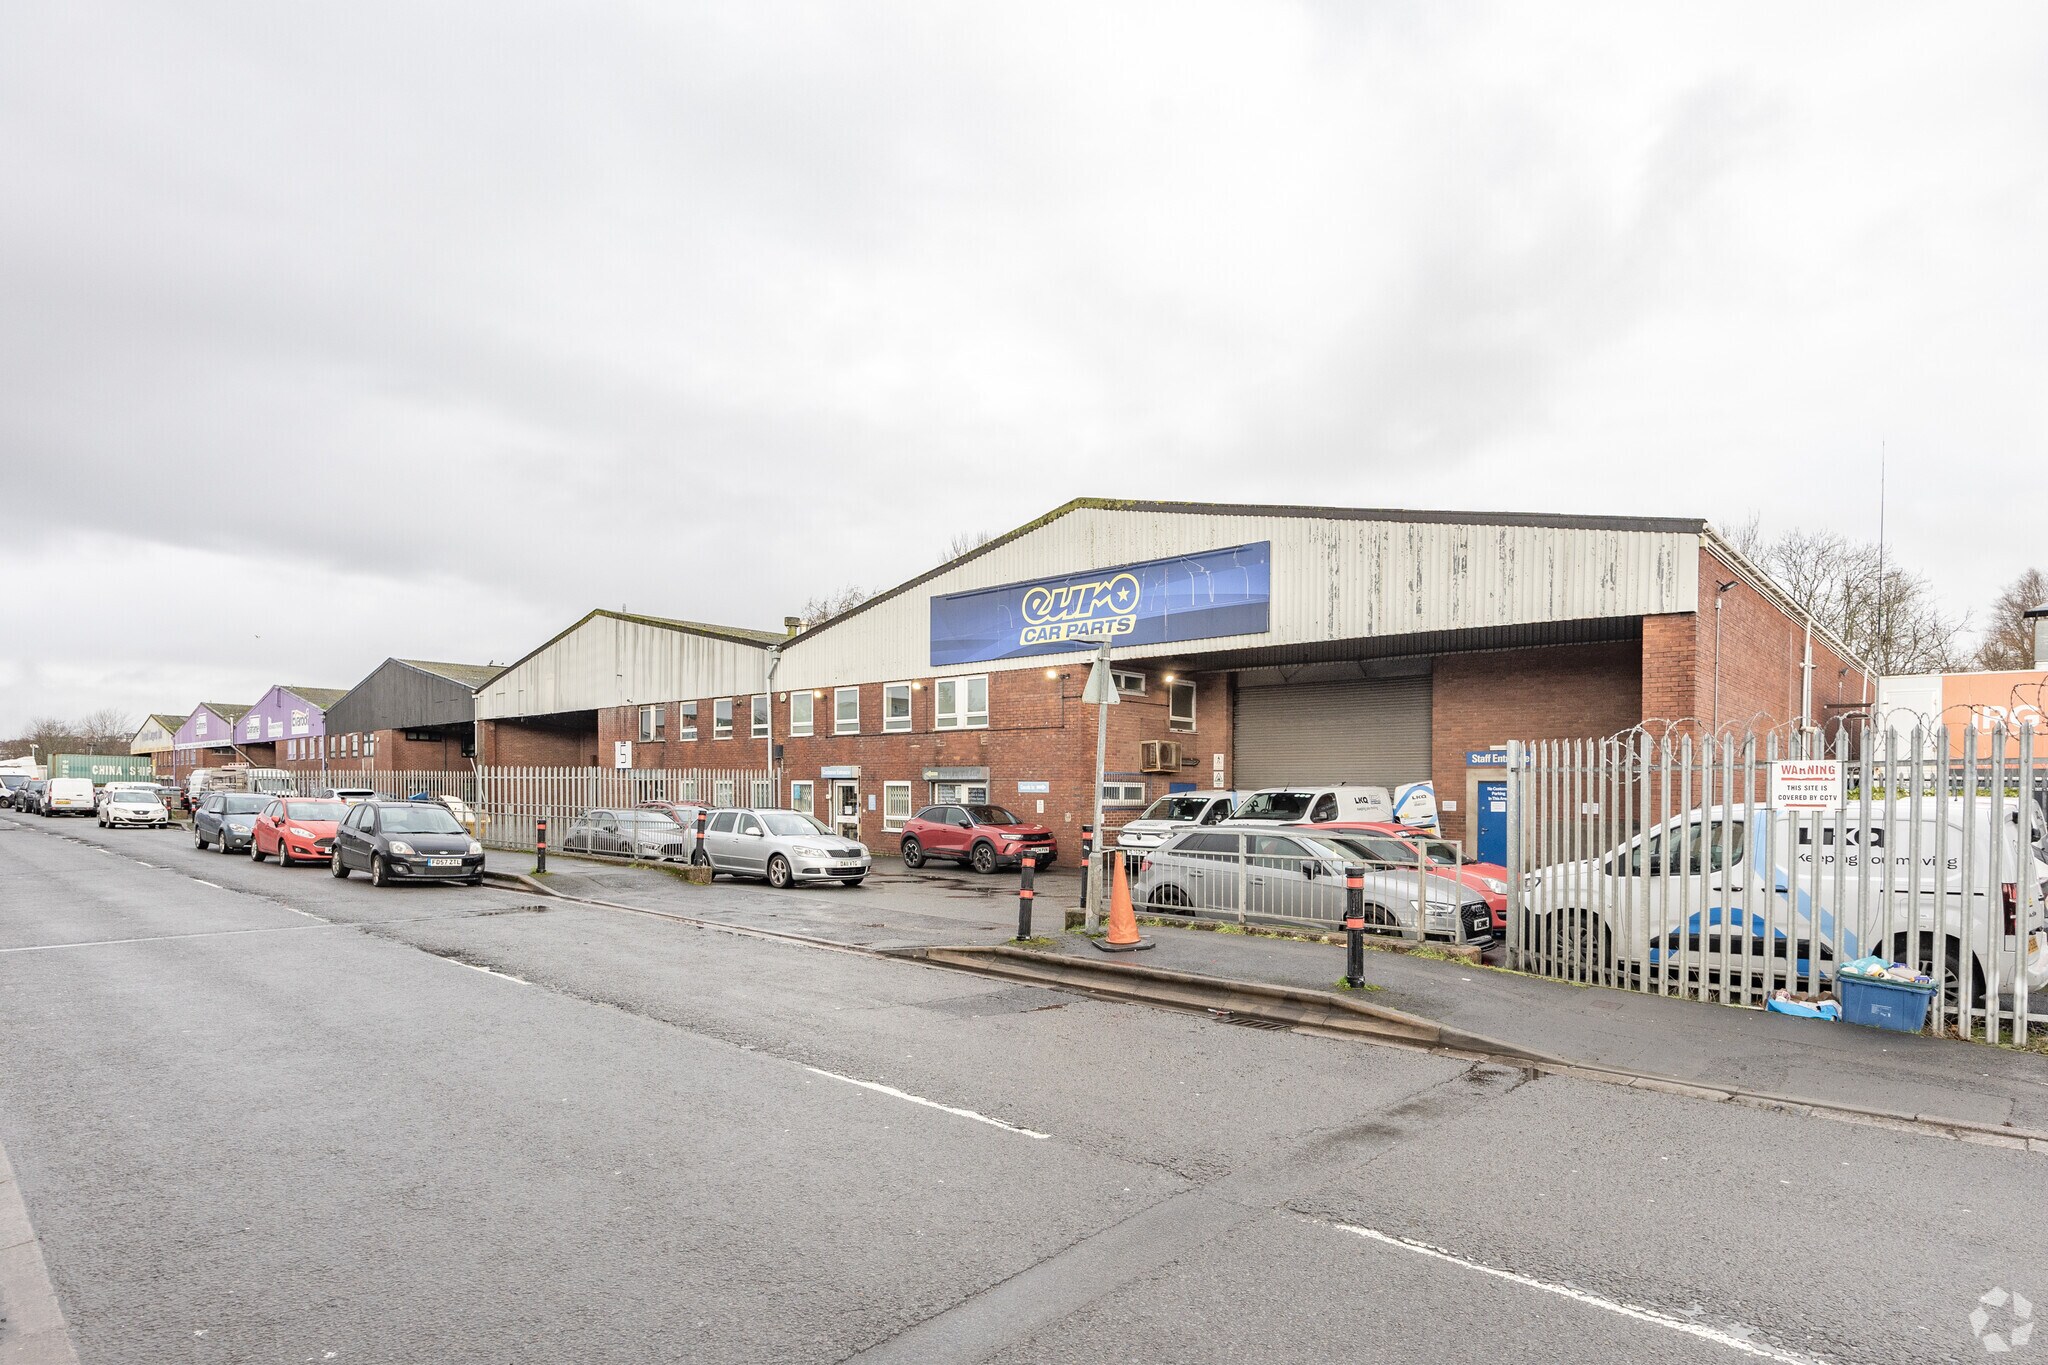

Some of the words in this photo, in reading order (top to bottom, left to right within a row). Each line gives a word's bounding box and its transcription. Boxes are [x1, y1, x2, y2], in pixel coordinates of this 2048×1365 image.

[1022, 574, 1139, 624] euro
[1024, 626, 1061, 643] CAR
[1066, 618, 1131, 637] PARTS
[1472, 754, 1491, 763] Staff
[92, 765, 122, 776] CHINA
[1354, 796, 1369, 804] LKQ
